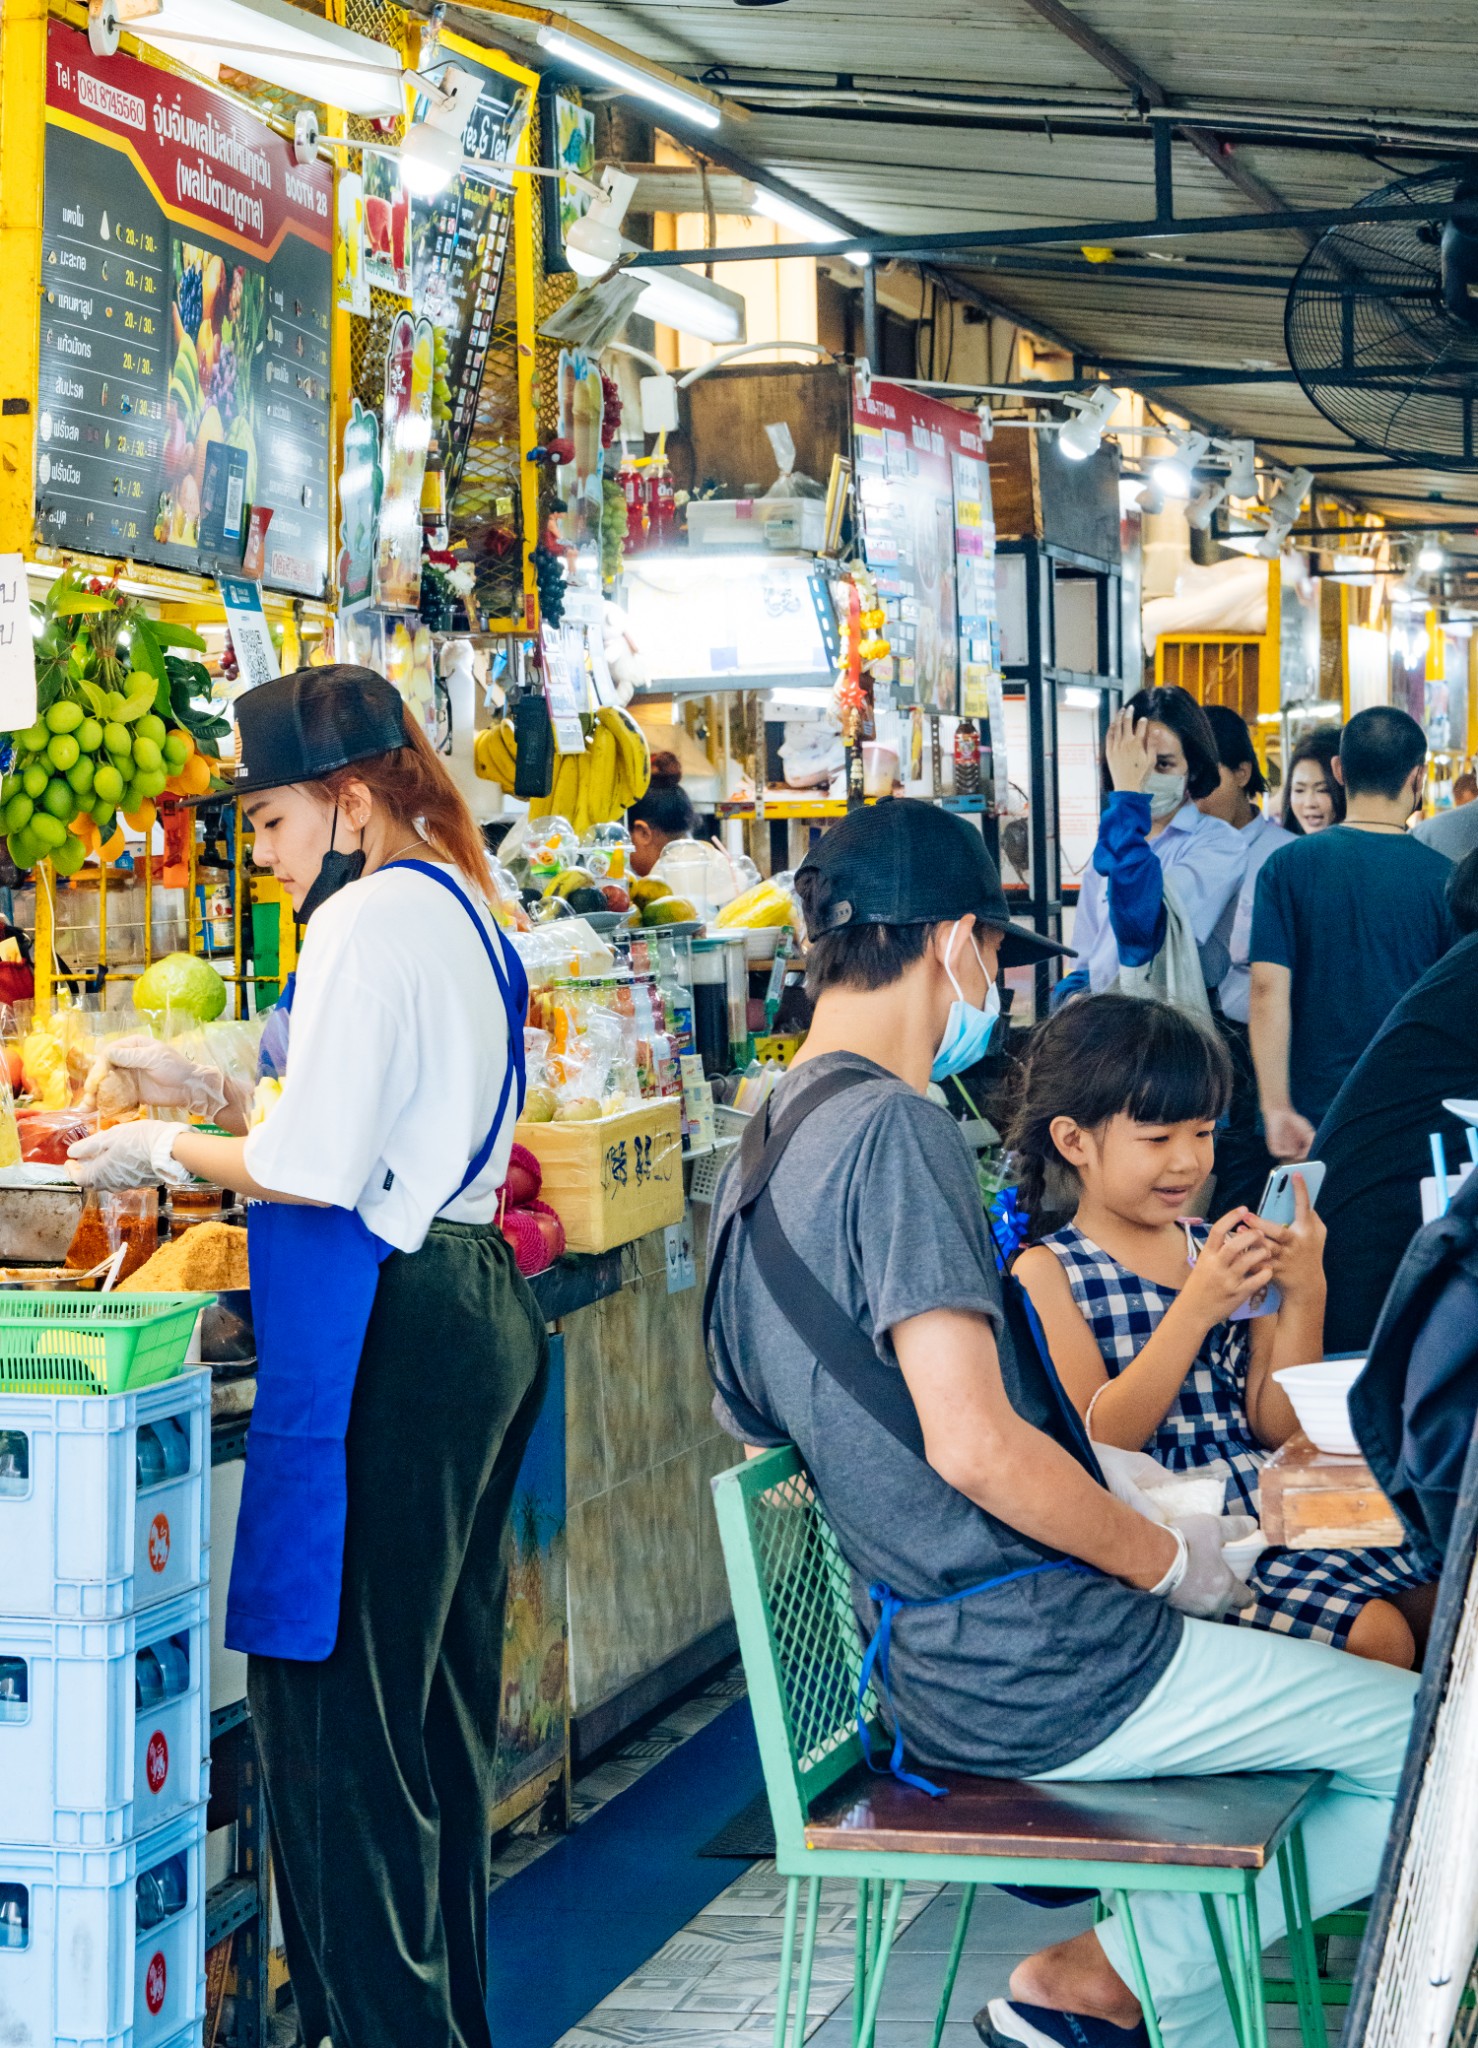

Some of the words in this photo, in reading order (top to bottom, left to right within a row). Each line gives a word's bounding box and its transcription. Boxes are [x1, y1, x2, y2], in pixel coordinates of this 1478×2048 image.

[55, 61, 70, 90] Tel
[285, 172, 314, 211] BOOTH
[316, 190, 328, 217] 28
[60, 250, 87, 272] มะละกอ
[58, 294, 93, 320] แคนตาลูป
